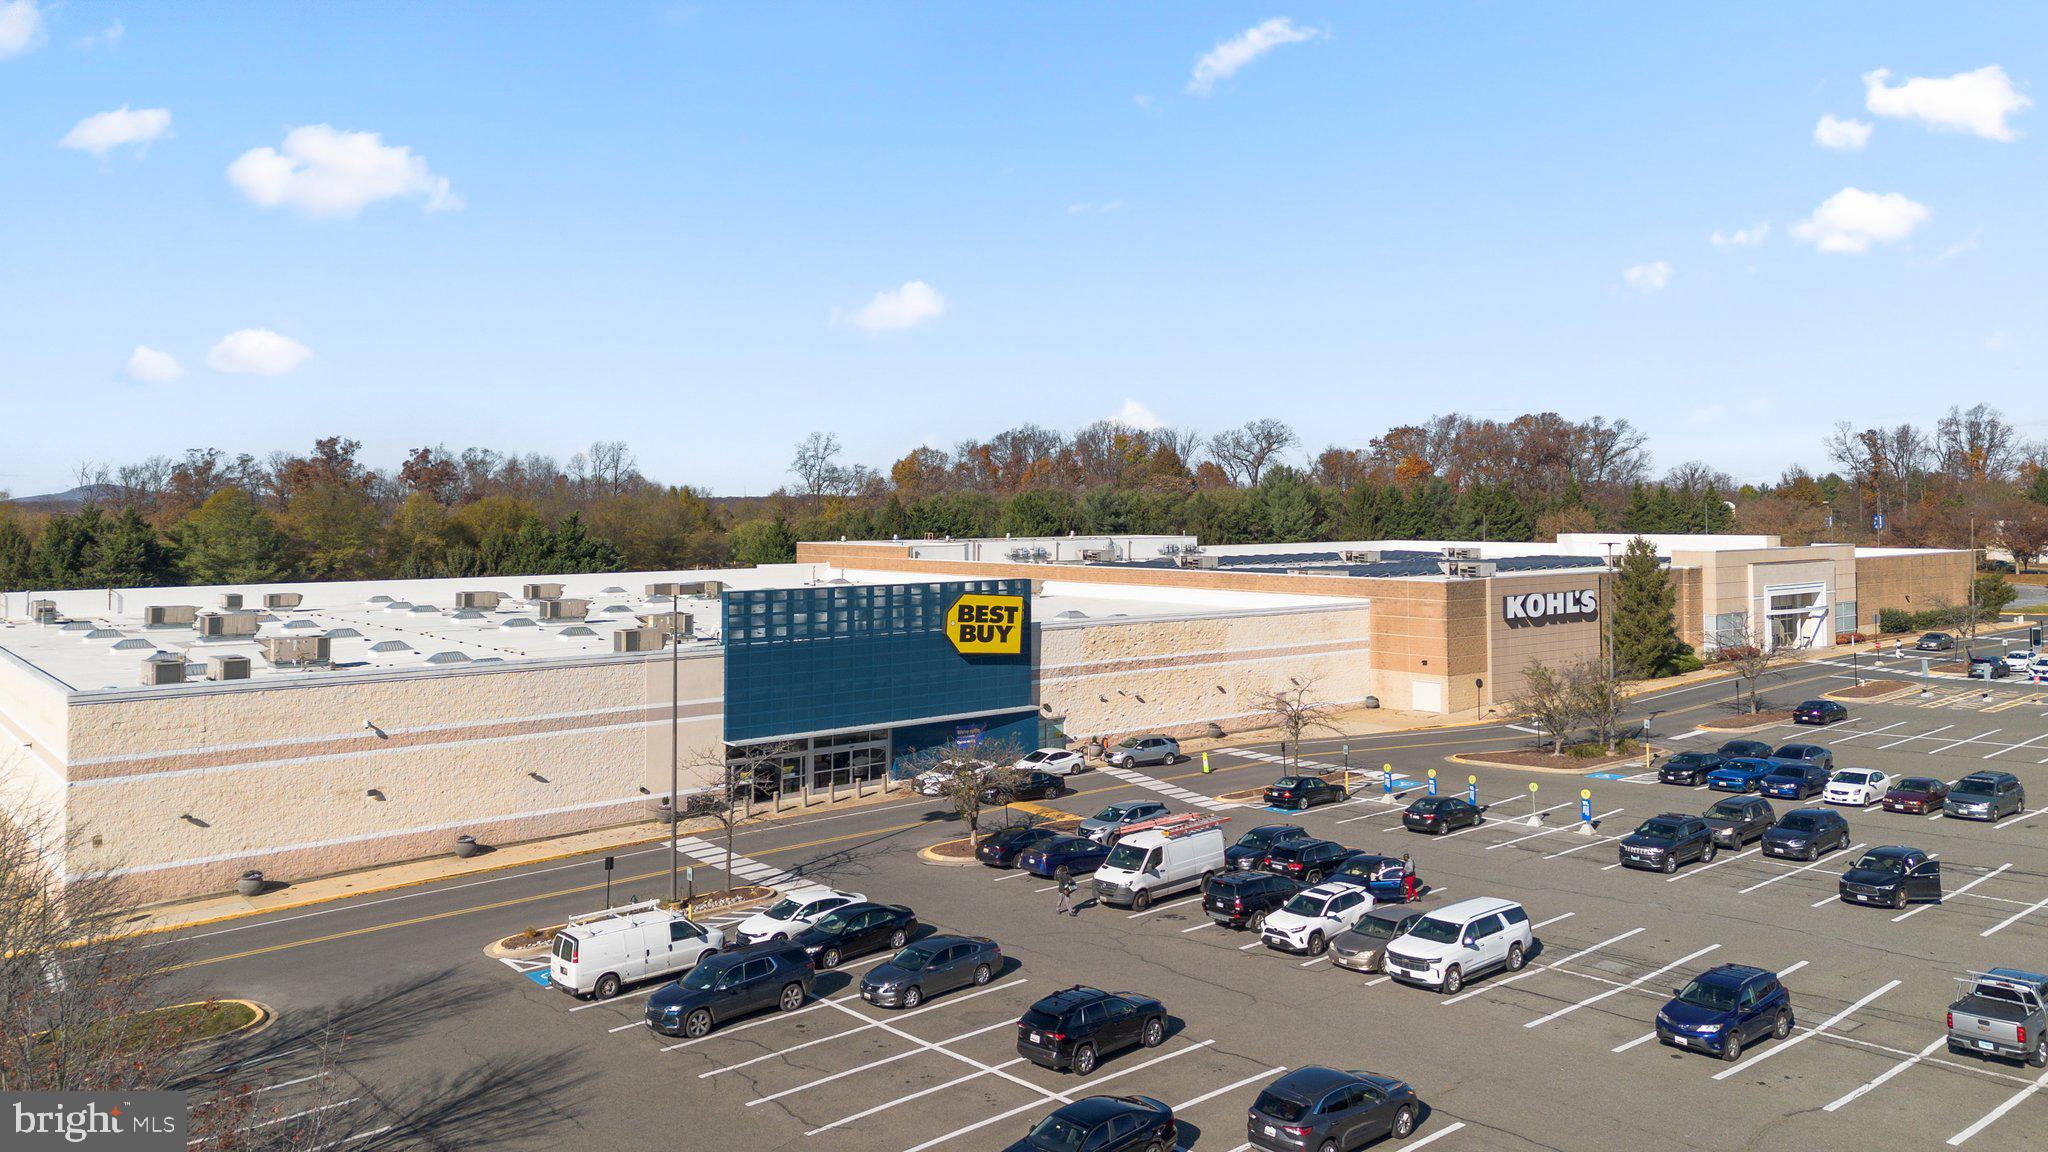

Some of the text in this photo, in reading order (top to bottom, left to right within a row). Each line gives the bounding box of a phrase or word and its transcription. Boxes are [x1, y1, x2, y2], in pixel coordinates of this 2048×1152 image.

[957, 604, 1019, 624] BEST
[1505, 589, 1597, 619] KOHL'S
[959, 624, 1014, 643] BUY
